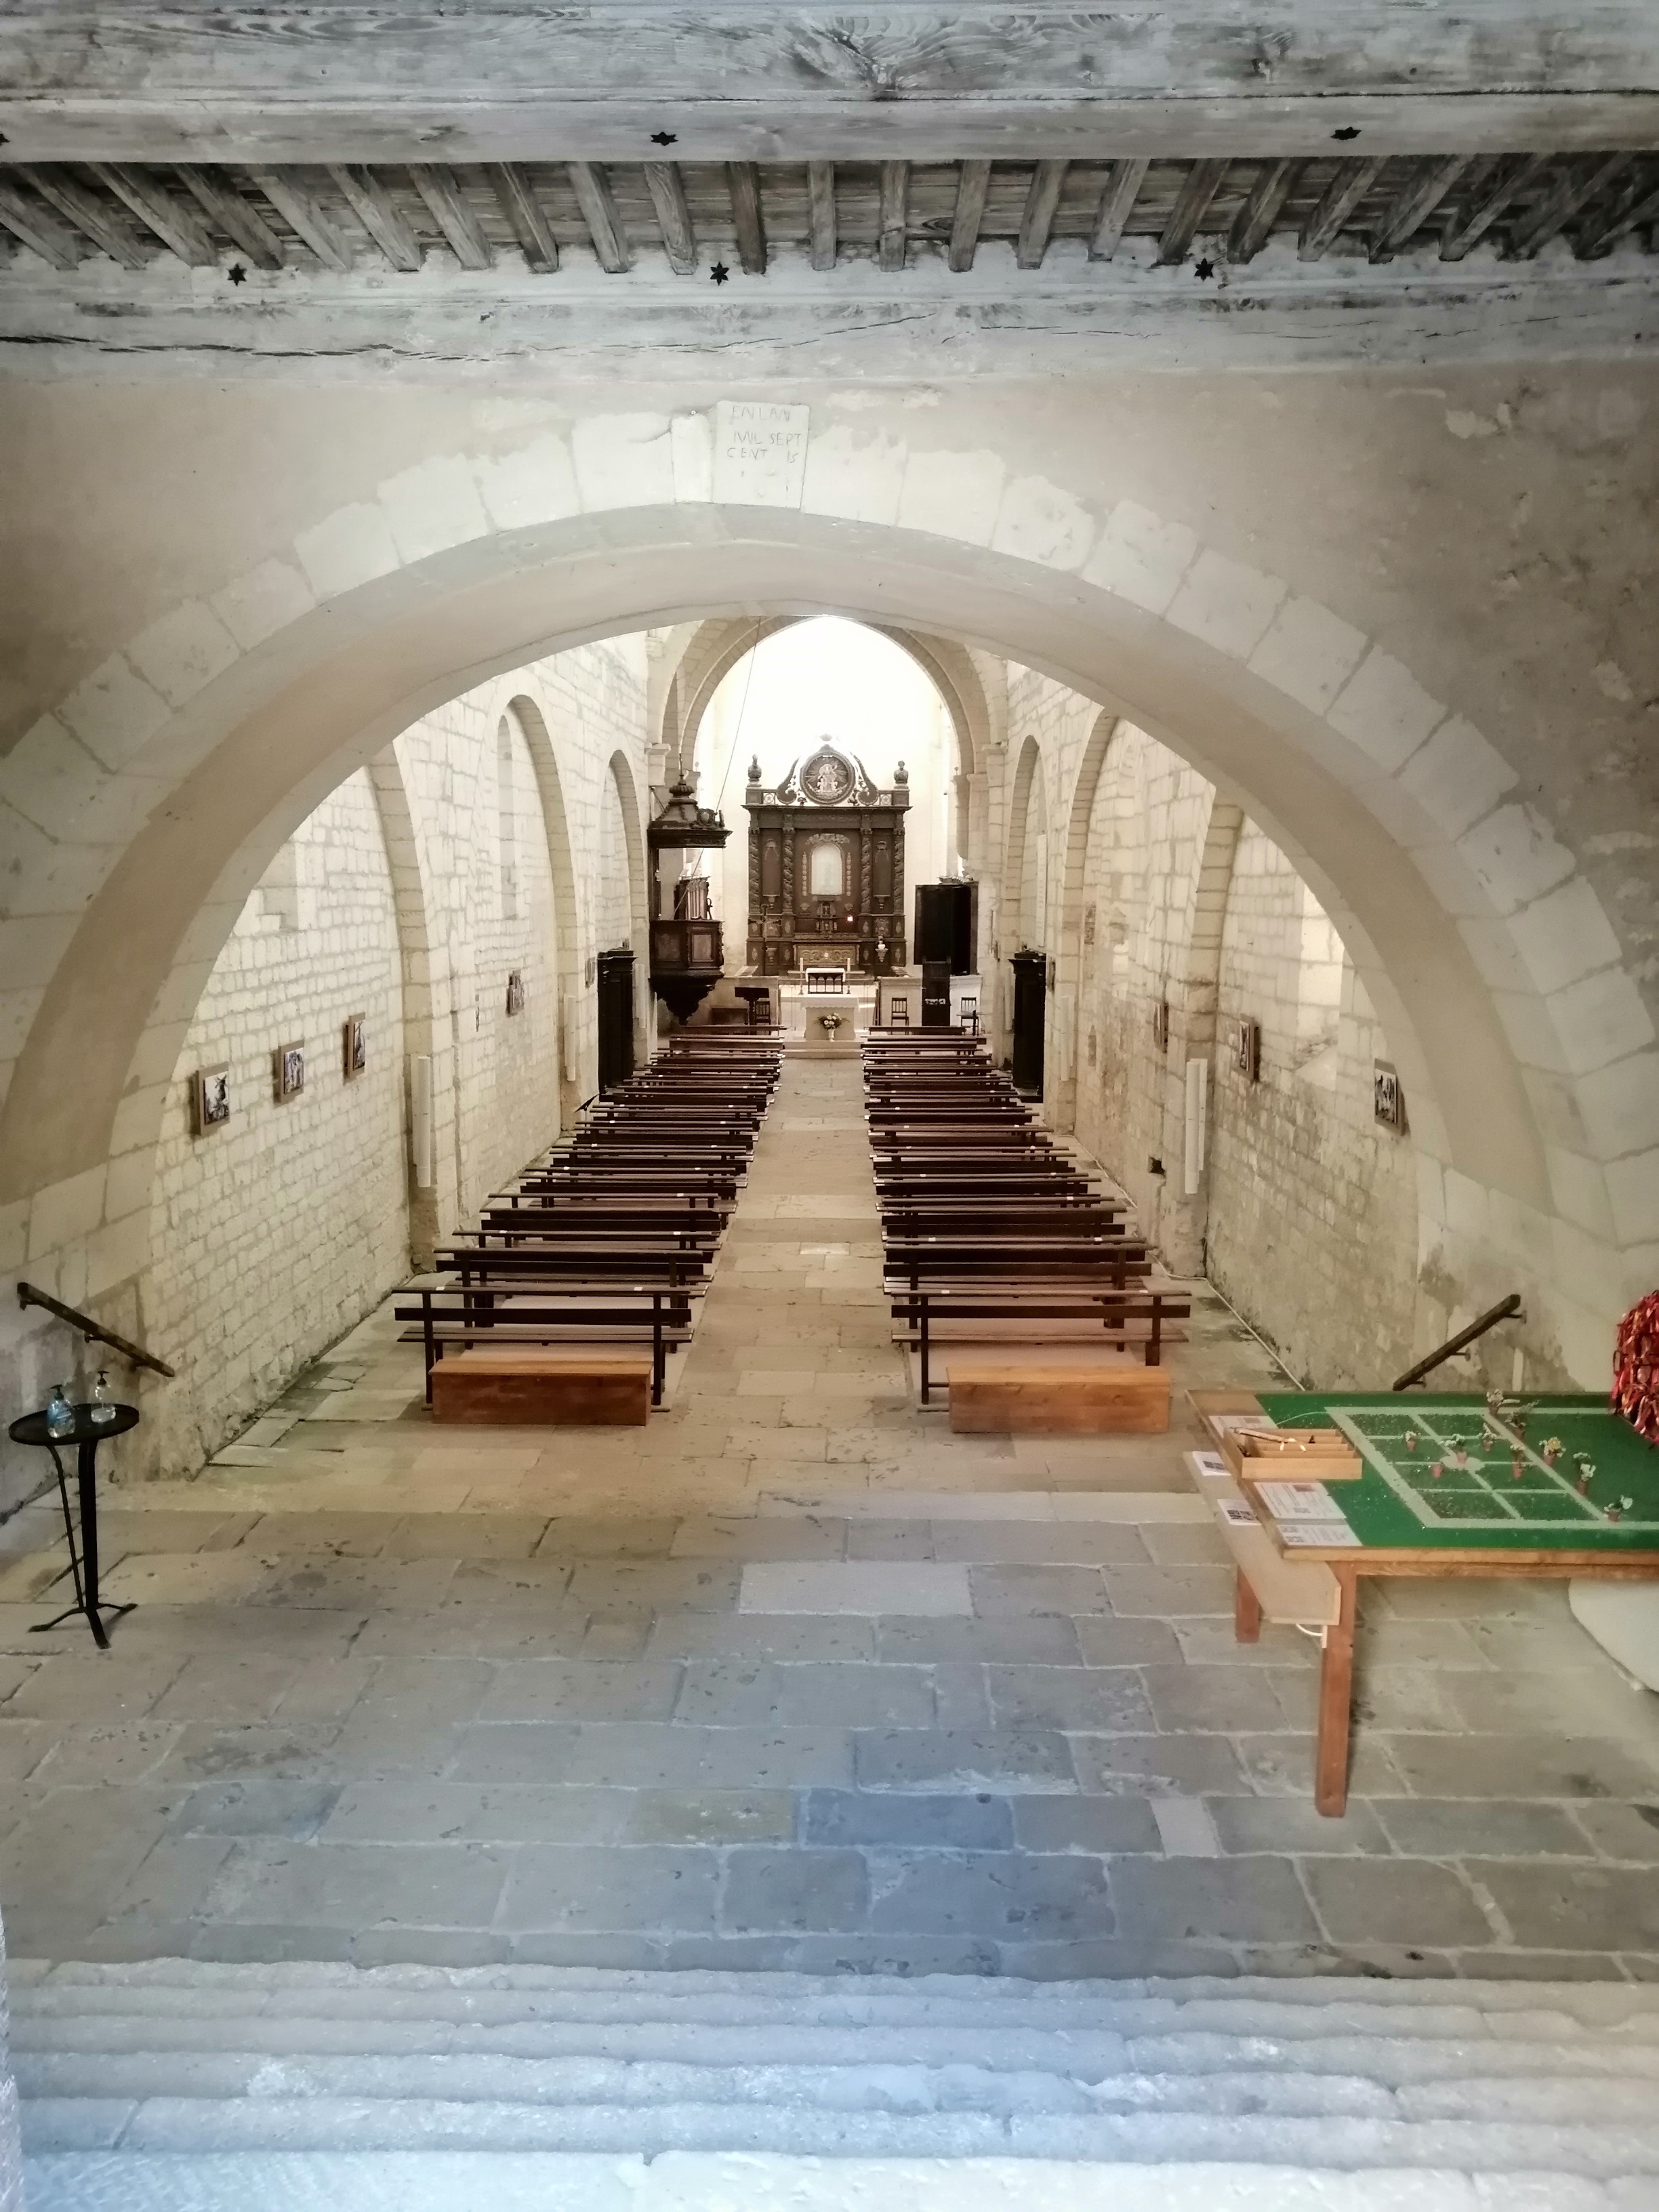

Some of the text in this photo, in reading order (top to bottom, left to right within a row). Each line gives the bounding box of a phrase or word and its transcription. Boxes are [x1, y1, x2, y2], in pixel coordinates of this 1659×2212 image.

[733, 431, 801, 447] MIL SEPT
[727, 447, 768, 459] CENT
